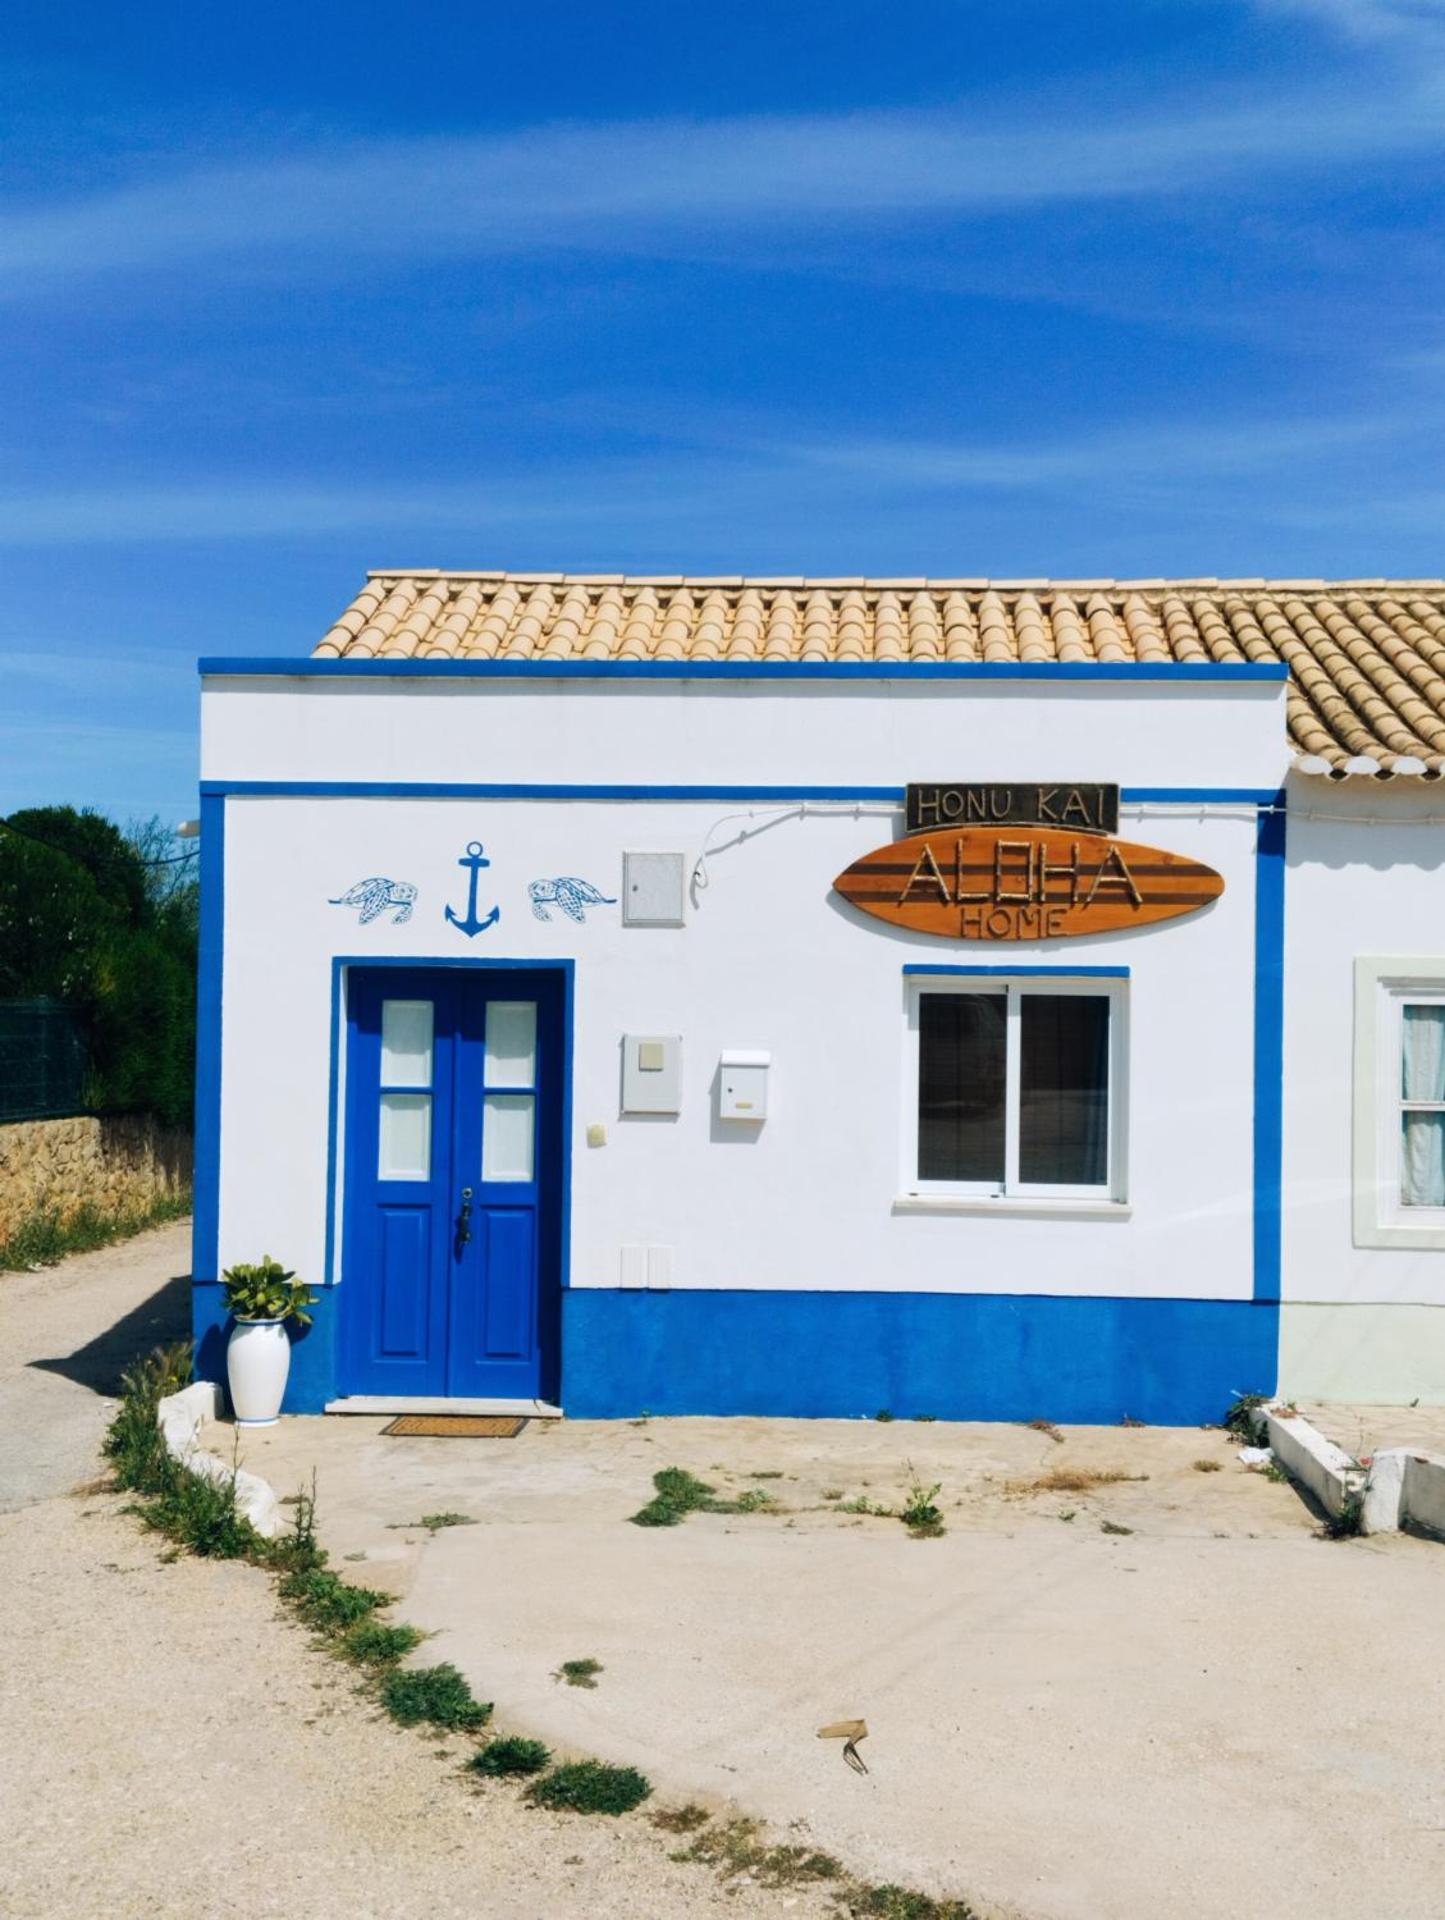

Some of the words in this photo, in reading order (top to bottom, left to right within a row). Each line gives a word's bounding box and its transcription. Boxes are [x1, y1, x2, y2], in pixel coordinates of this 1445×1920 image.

[918, 788, 1012, 824] HONU
[1037, 788, 1105, 825] KAI
[899, 838, 1144, 906] ALOHA
[960, 907, 1069, 938] HOME
